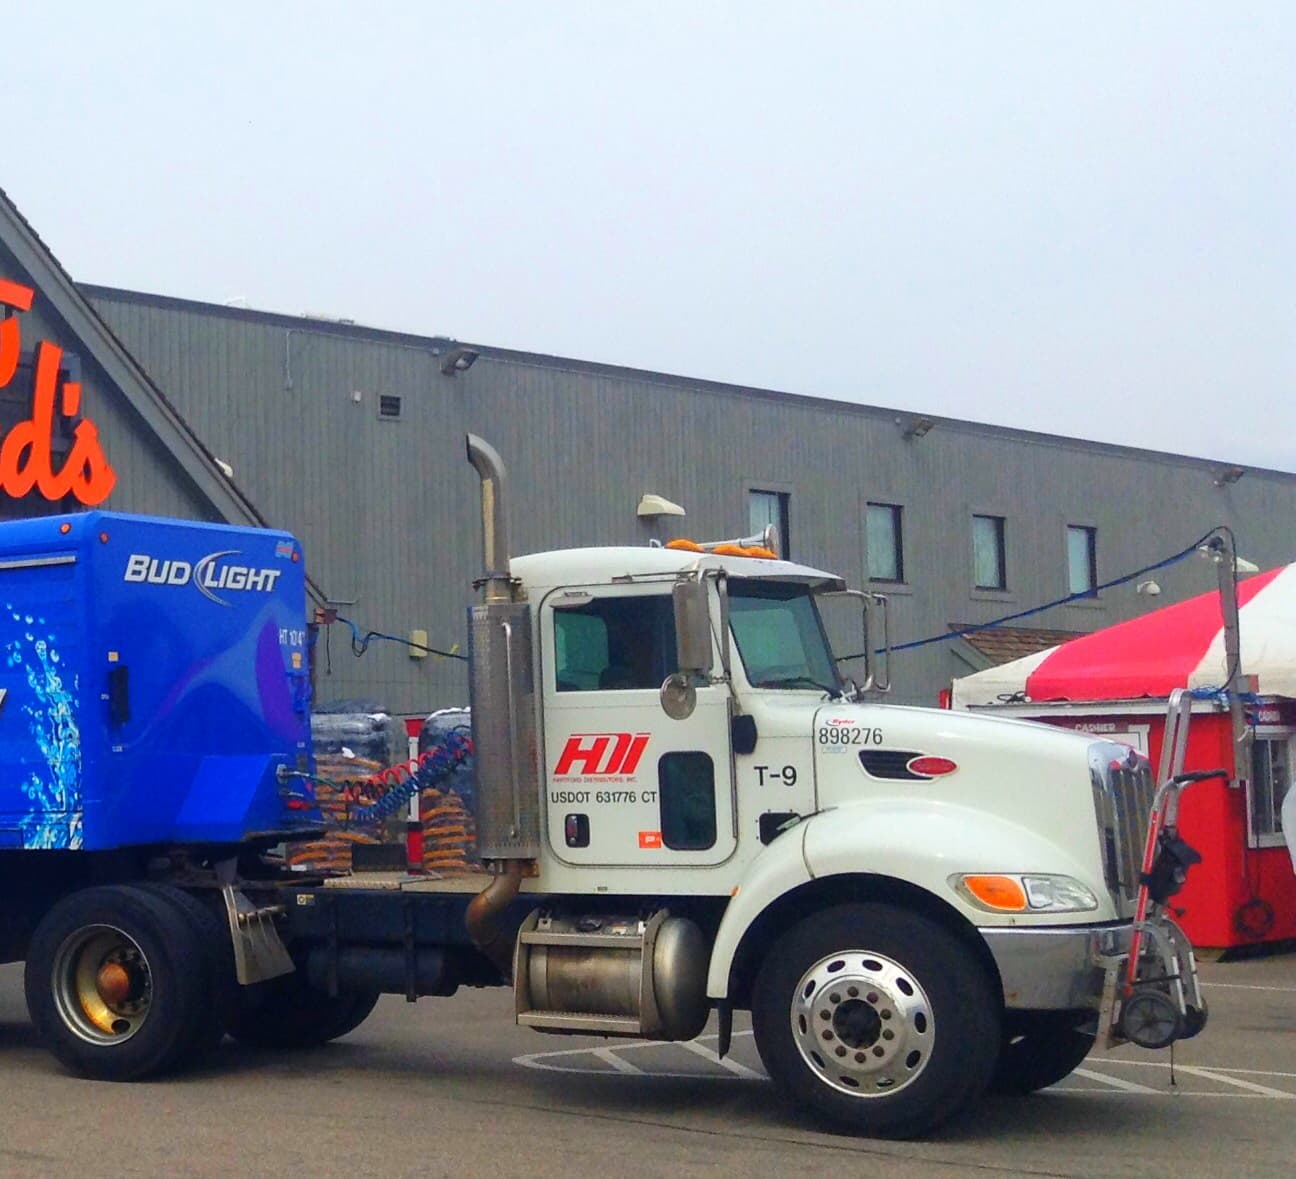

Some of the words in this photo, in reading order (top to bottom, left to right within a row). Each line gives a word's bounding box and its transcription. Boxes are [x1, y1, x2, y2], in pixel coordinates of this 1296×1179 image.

[124, 555, 191, 586] BUD
[204, 559, 280, 592] LIGHT
[819, 727, 883, 745] 898276
[554, 732, 651, 775] HDI
[754, 765, 797, 787] T-9
[551, 791, 591, 803] USDOT
[596, 791, 637, 803] 631776
[641, 791, 658, 803] CT
